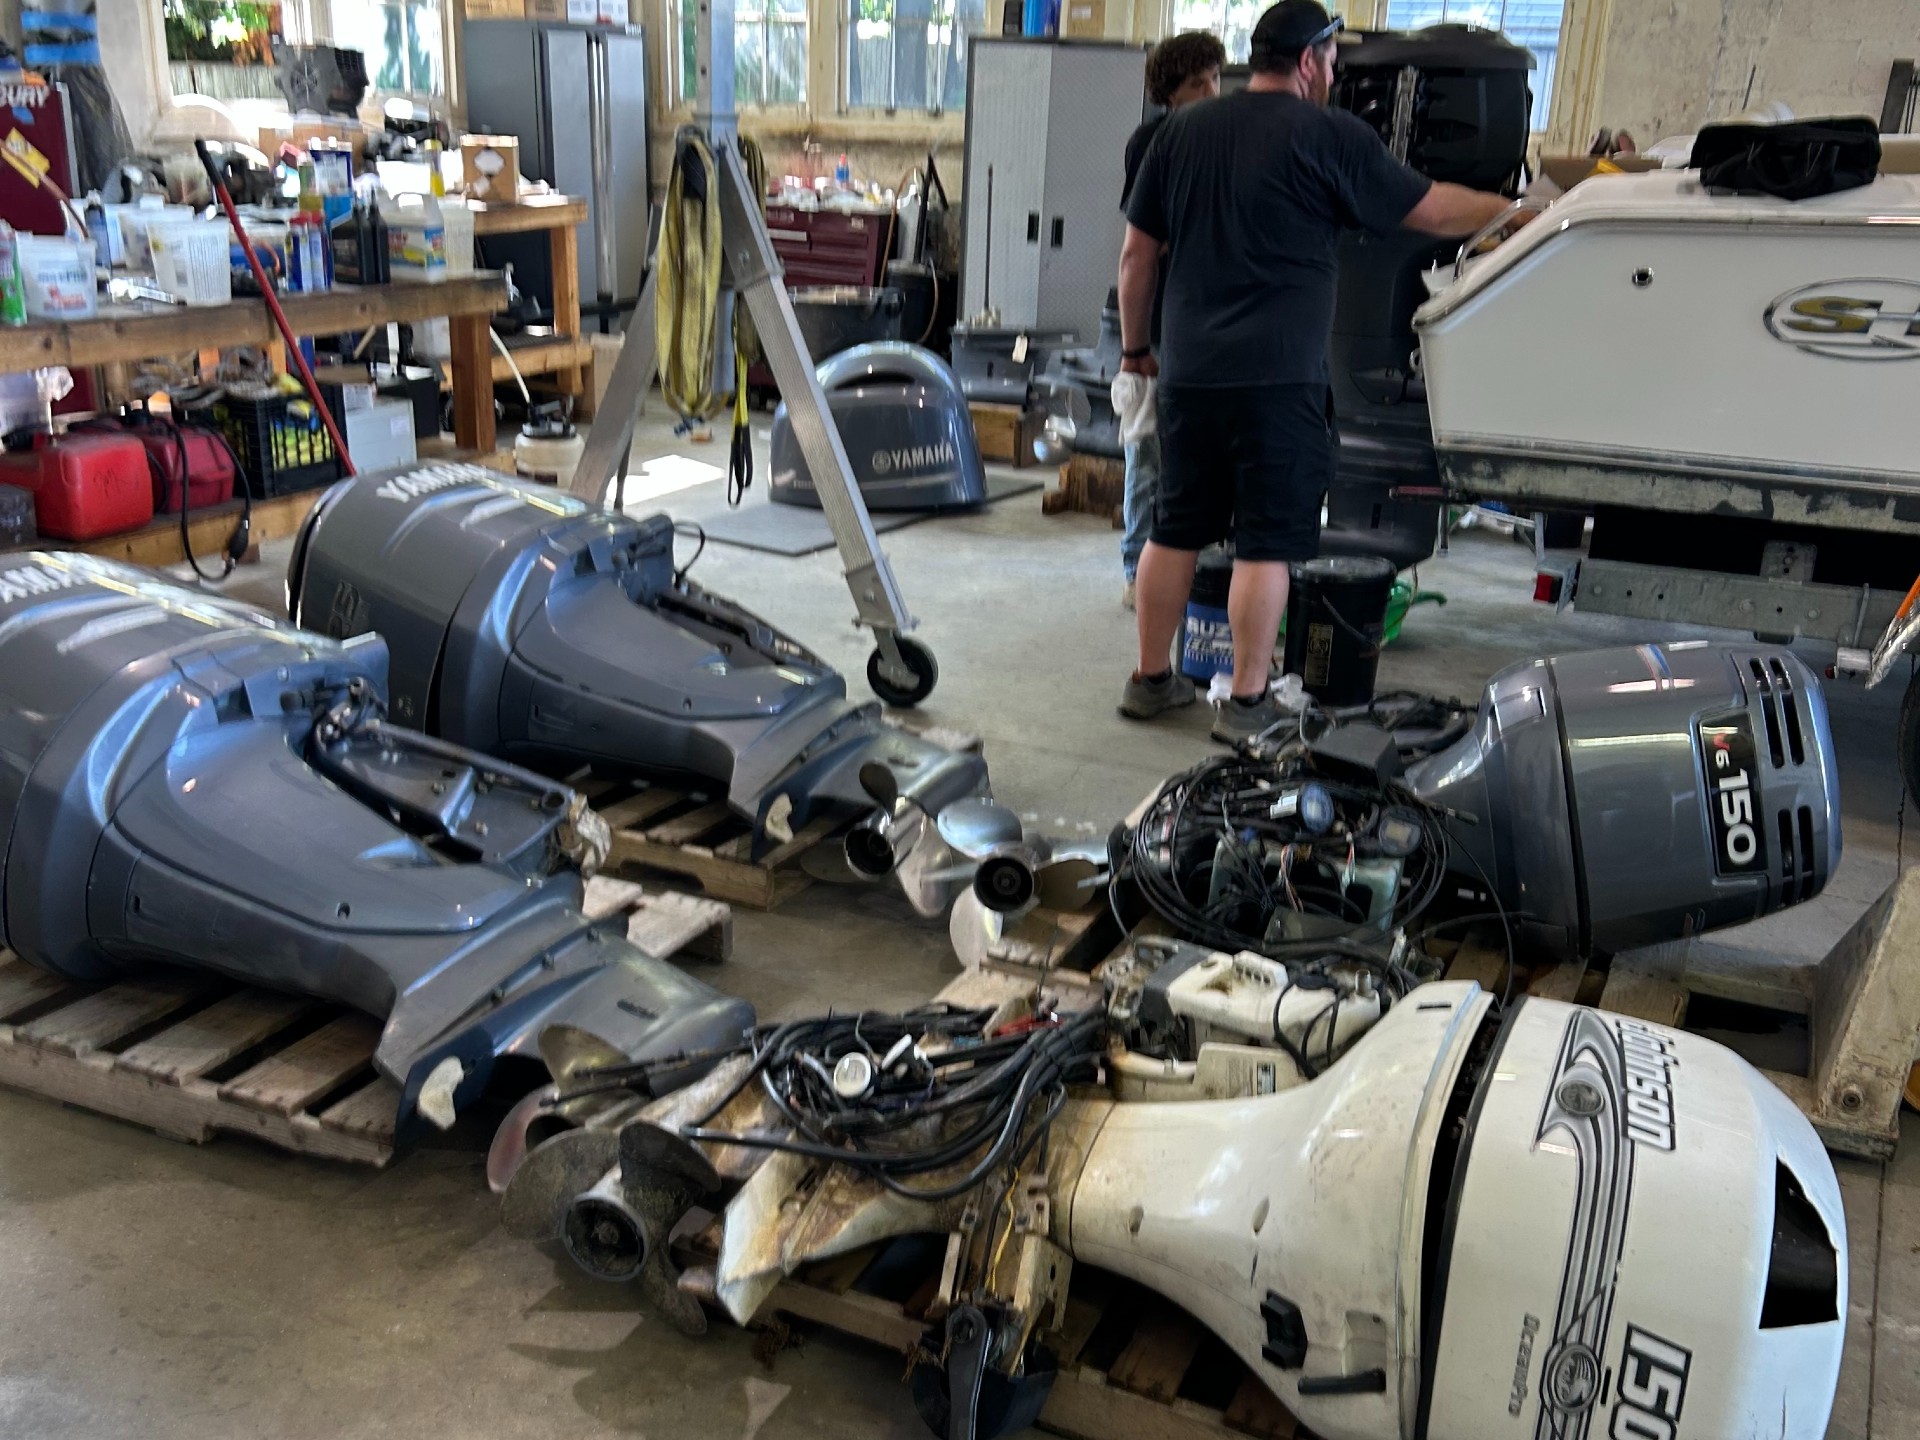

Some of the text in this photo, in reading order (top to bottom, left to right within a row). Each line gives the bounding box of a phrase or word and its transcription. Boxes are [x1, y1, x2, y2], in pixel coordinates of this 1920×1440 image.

[891, 442, 955, 471] YAMAHA
[1719, 768, 1757, 865] 150
[1608, 1321, 1693, 1440] 150
